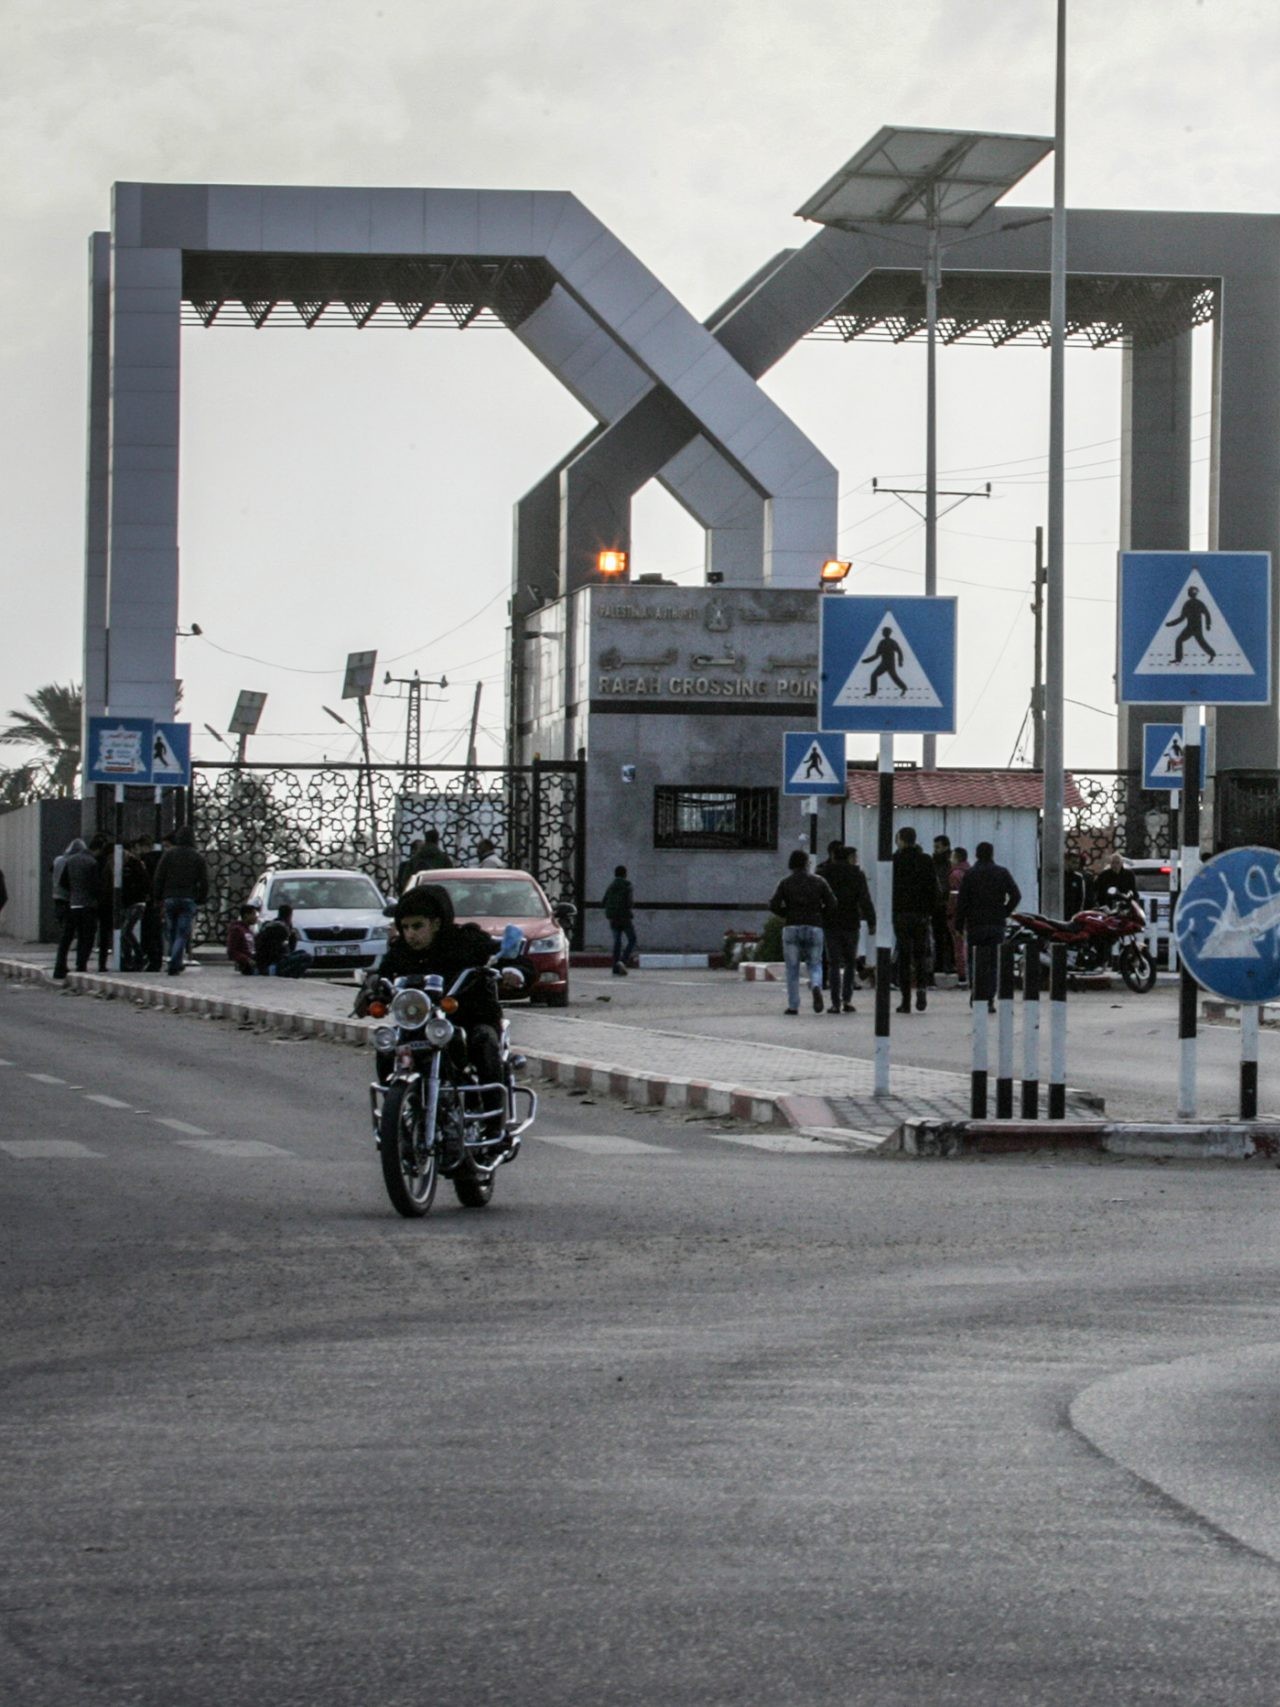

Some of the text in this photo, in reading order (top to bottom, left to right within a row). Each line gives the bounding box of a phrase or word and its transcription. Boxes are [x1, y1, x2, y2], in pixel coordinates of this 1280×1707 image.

[598, 677, 819, 697] RAFAH CROSSING POIN
